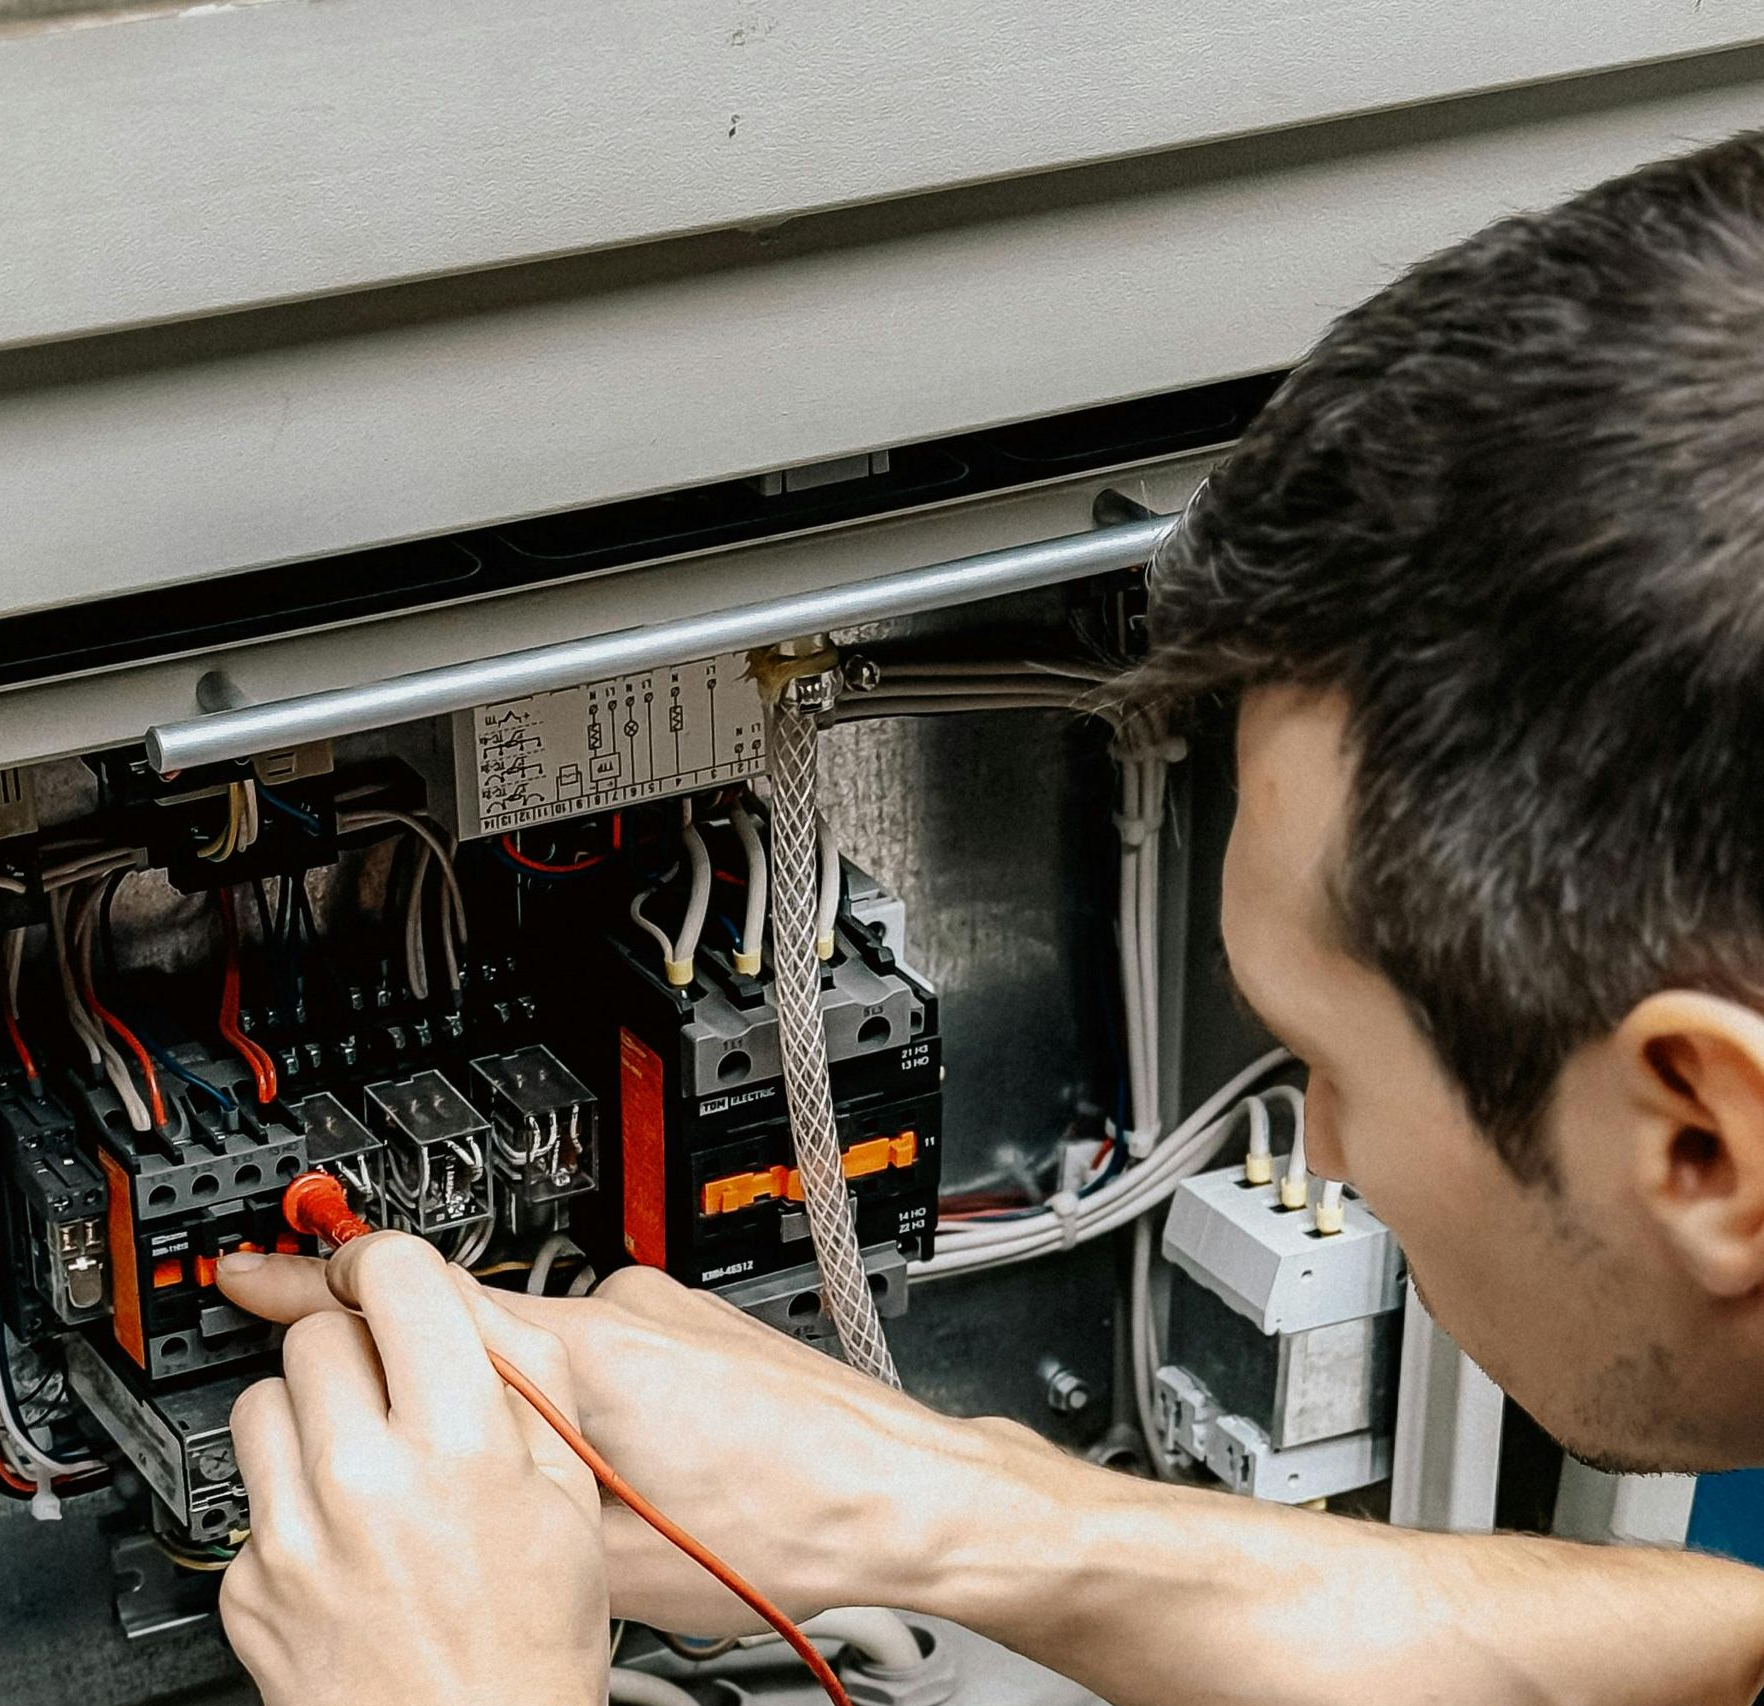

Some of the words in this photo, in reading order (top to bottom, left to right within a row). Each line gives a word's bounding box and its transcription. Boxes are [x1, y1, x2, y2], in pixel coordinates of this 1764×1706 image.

[737, 763, 744, 773] 2
[711, 769, 718, 780] 3
[630, 783, 637, 793] 6
[648, 782, 655, 793] 5
[611, 790, 619, 801] 7
[555, 803, 567, 814] 10
[576, 799, 583, 809] 9
[519, 811, 530, 822] 12
[537, 807, 548, 818] 11
[484, 818, 495, 830] 14
[501, 815, 512, 826] 13
[701, 1097, 728, 1115] TDM
[730, 1086, 776, 1107] ELECTRIC
